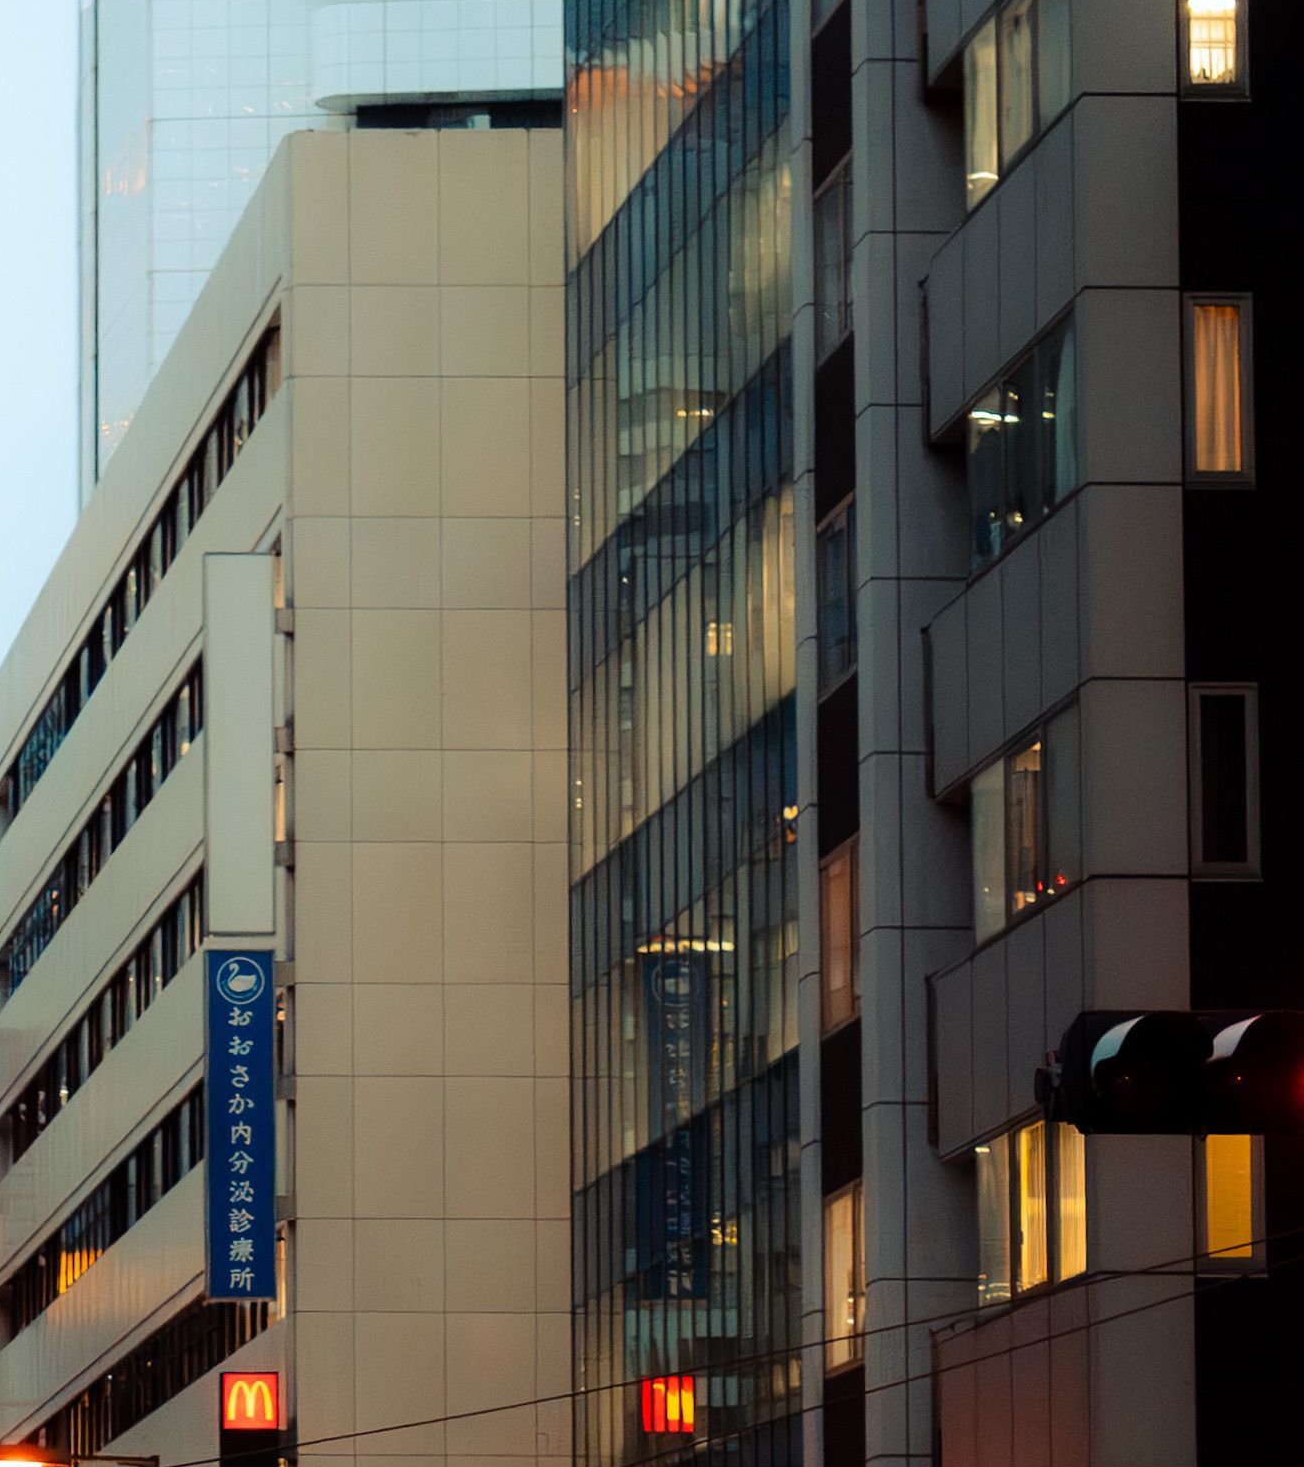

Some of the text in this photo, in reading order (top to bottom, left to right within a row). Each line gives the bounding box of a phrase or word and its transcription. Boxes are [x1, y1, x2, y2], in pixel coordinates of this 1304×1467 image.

[227, 1007, 255, 1292] おおさか内分泌診療所
